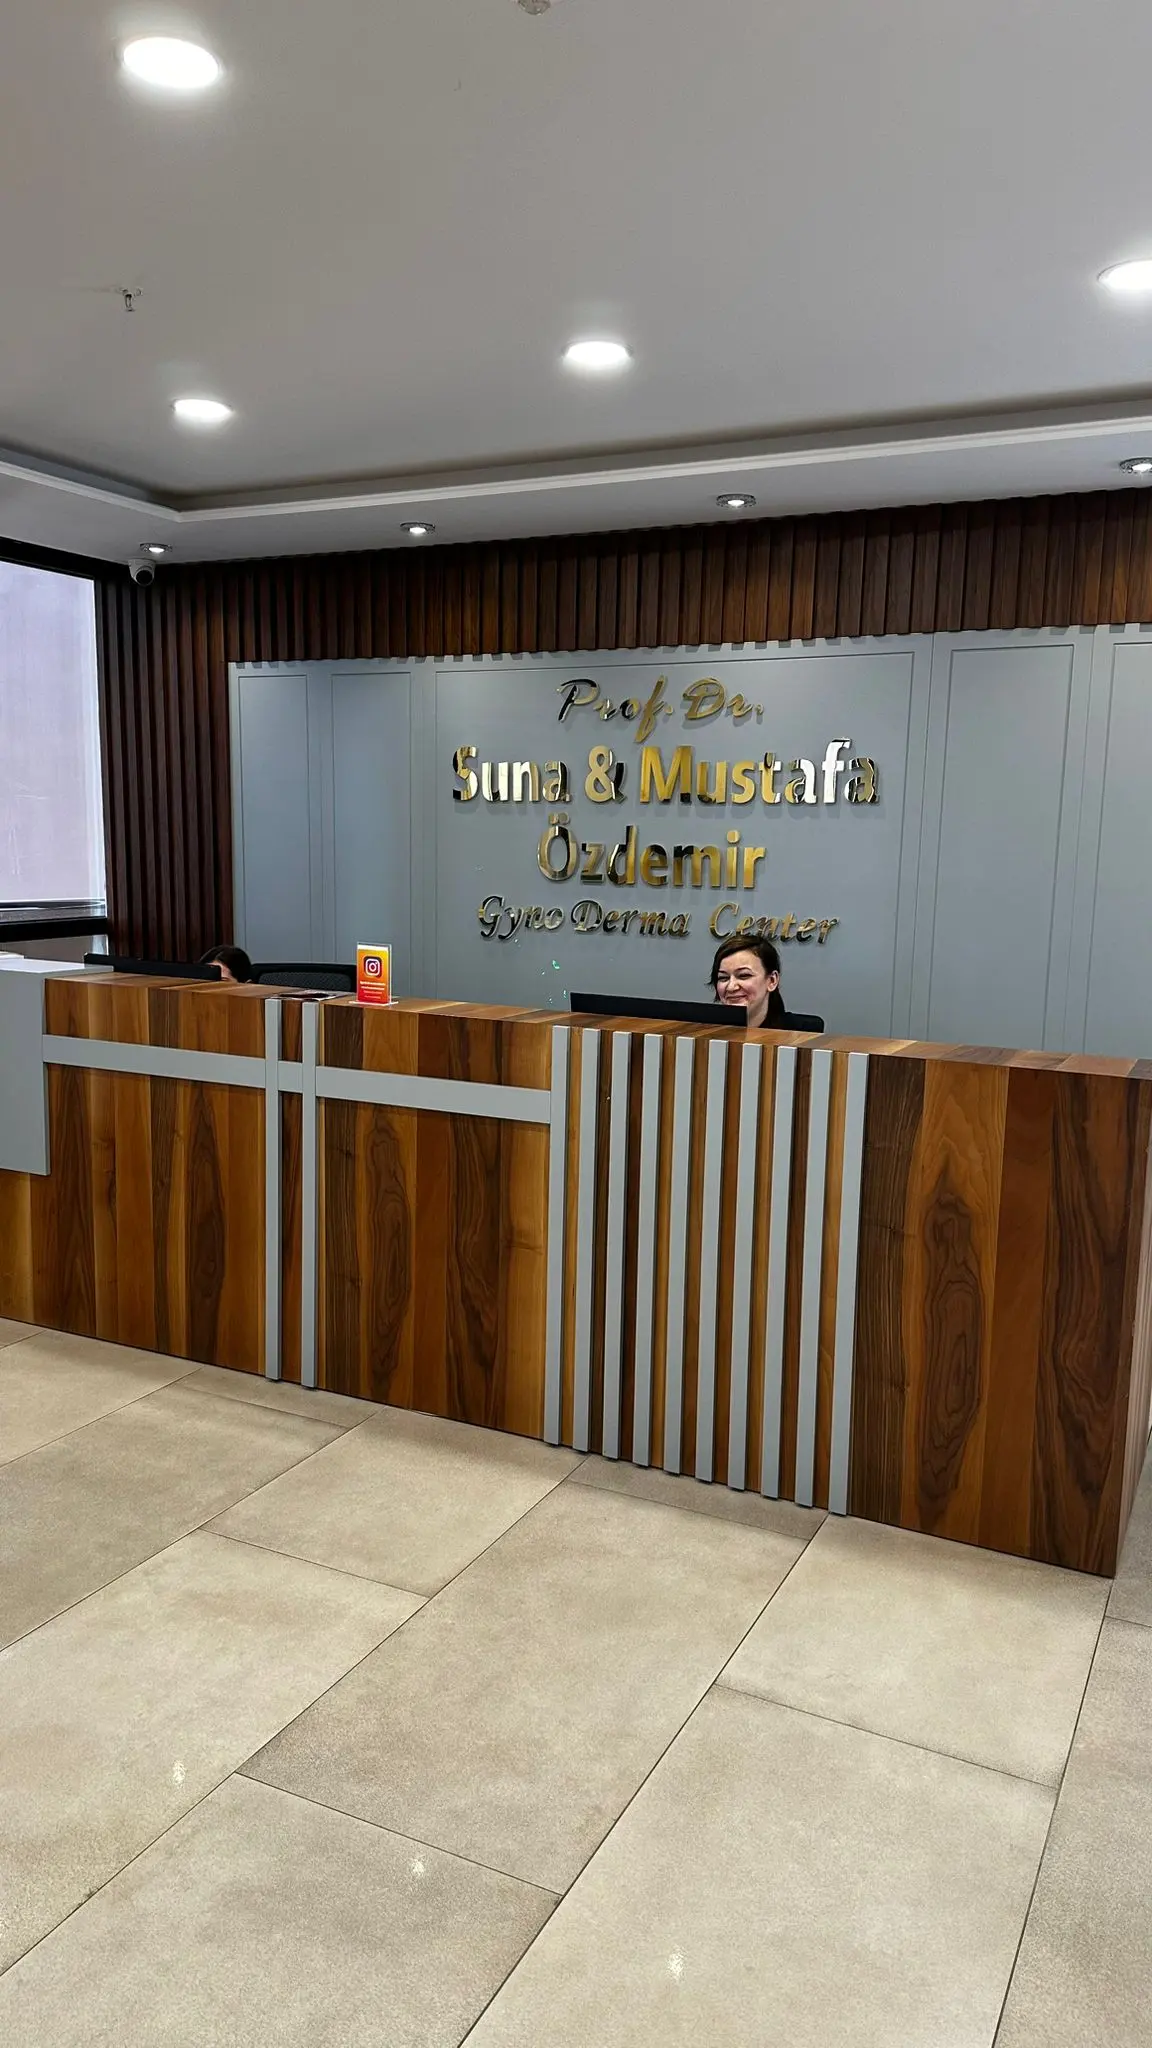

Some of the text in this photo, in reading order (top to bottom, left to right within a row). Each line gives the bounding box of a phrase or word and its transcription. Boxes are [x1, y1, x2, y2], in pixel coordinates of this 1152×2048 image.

[557, 675, 764, 743] Prof. Dr.
[452, 738, 881, 805] Suna & Mustafa
[537, 812, 767, 890] Özdemir
[478, 896, 839, 943] Gyno Derma Center
